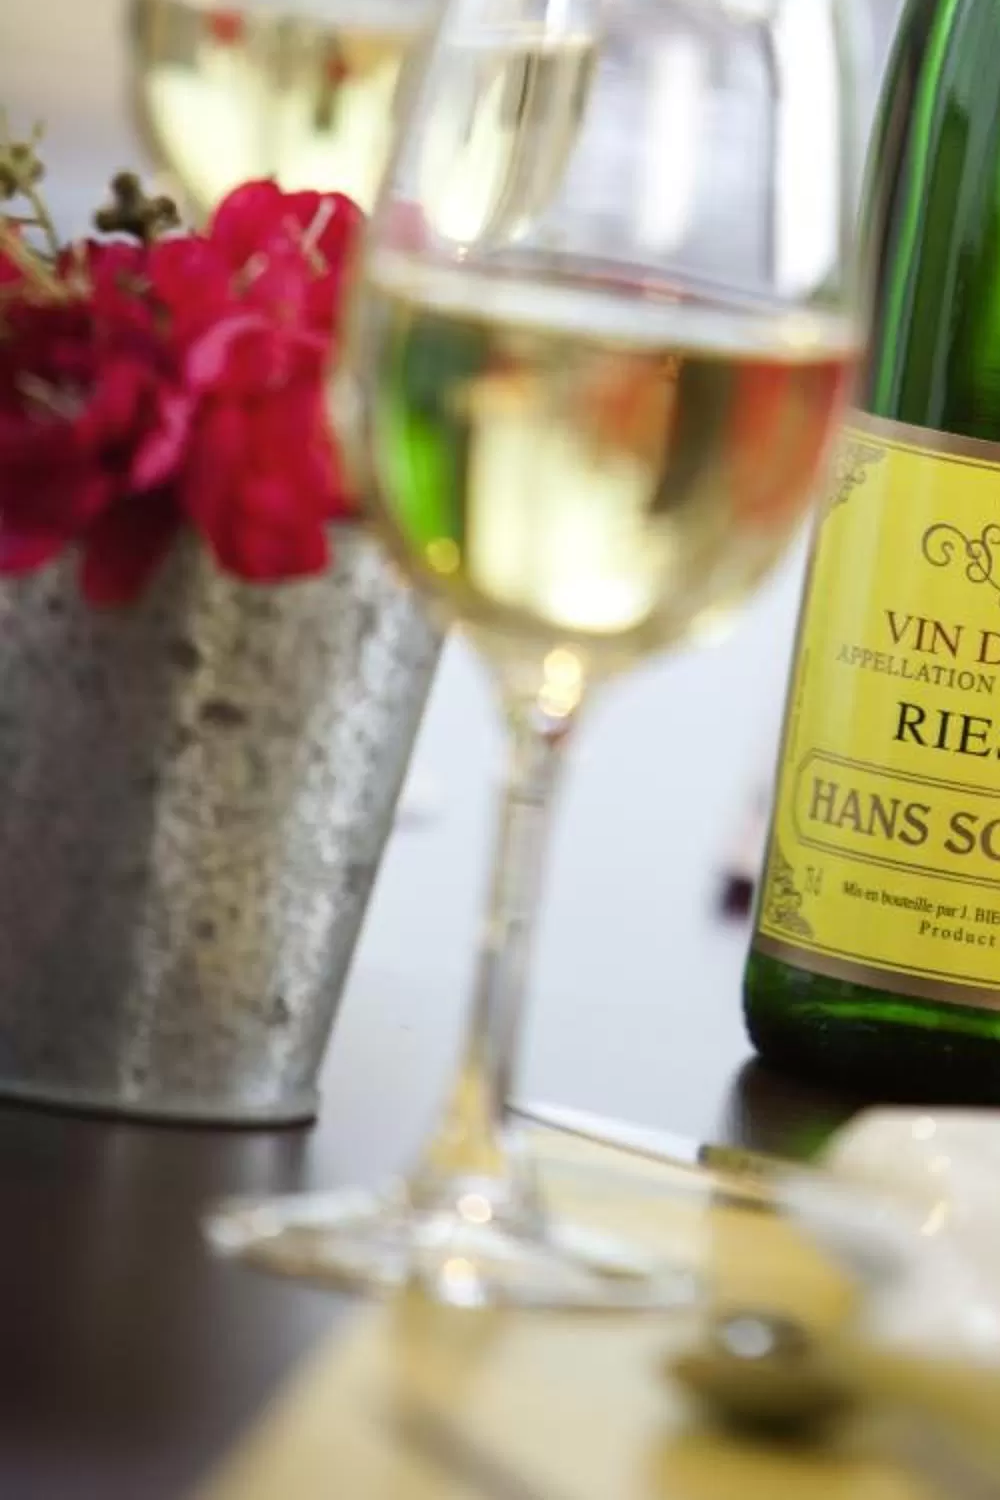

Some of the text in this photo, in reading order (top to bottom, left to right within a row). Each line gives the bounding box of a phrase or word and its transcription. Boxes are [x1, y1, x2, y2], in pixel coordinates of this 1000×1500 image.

[884, 609, 965, 660] VIN
[835, 643, 996, 695] APPELLATION
[807, 776, 931, 847] HANS
[918, 919, 996, 948] Product
